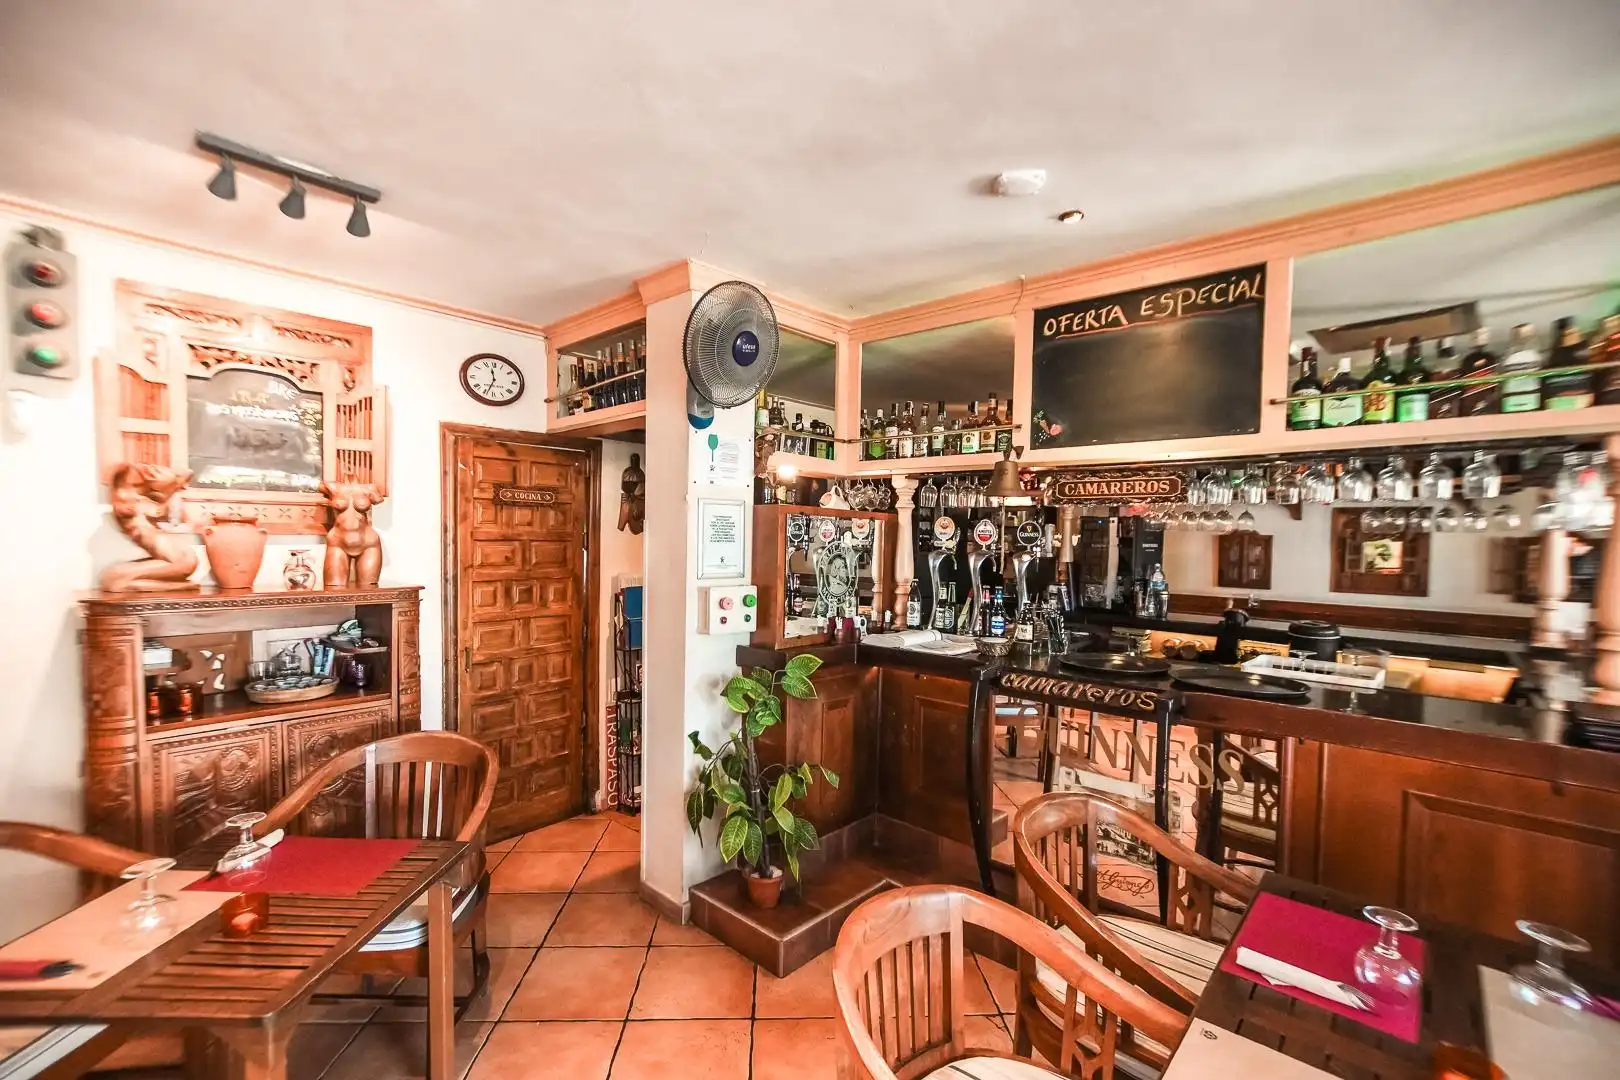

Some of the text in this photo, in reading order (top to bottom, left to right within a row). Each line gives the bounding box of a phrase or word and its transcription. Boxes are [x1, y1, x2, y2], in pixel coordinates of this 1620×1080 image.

[1043, 271, 1264, 337] OFERTA ESPECIAL
[514, 491, 542, 501] COCINA
[1064, 480, 1170, 496] CAMAREROS
[1000, 672, 1159, 711] camareros
[1015, 704, 1245, 796] GUINNESS
